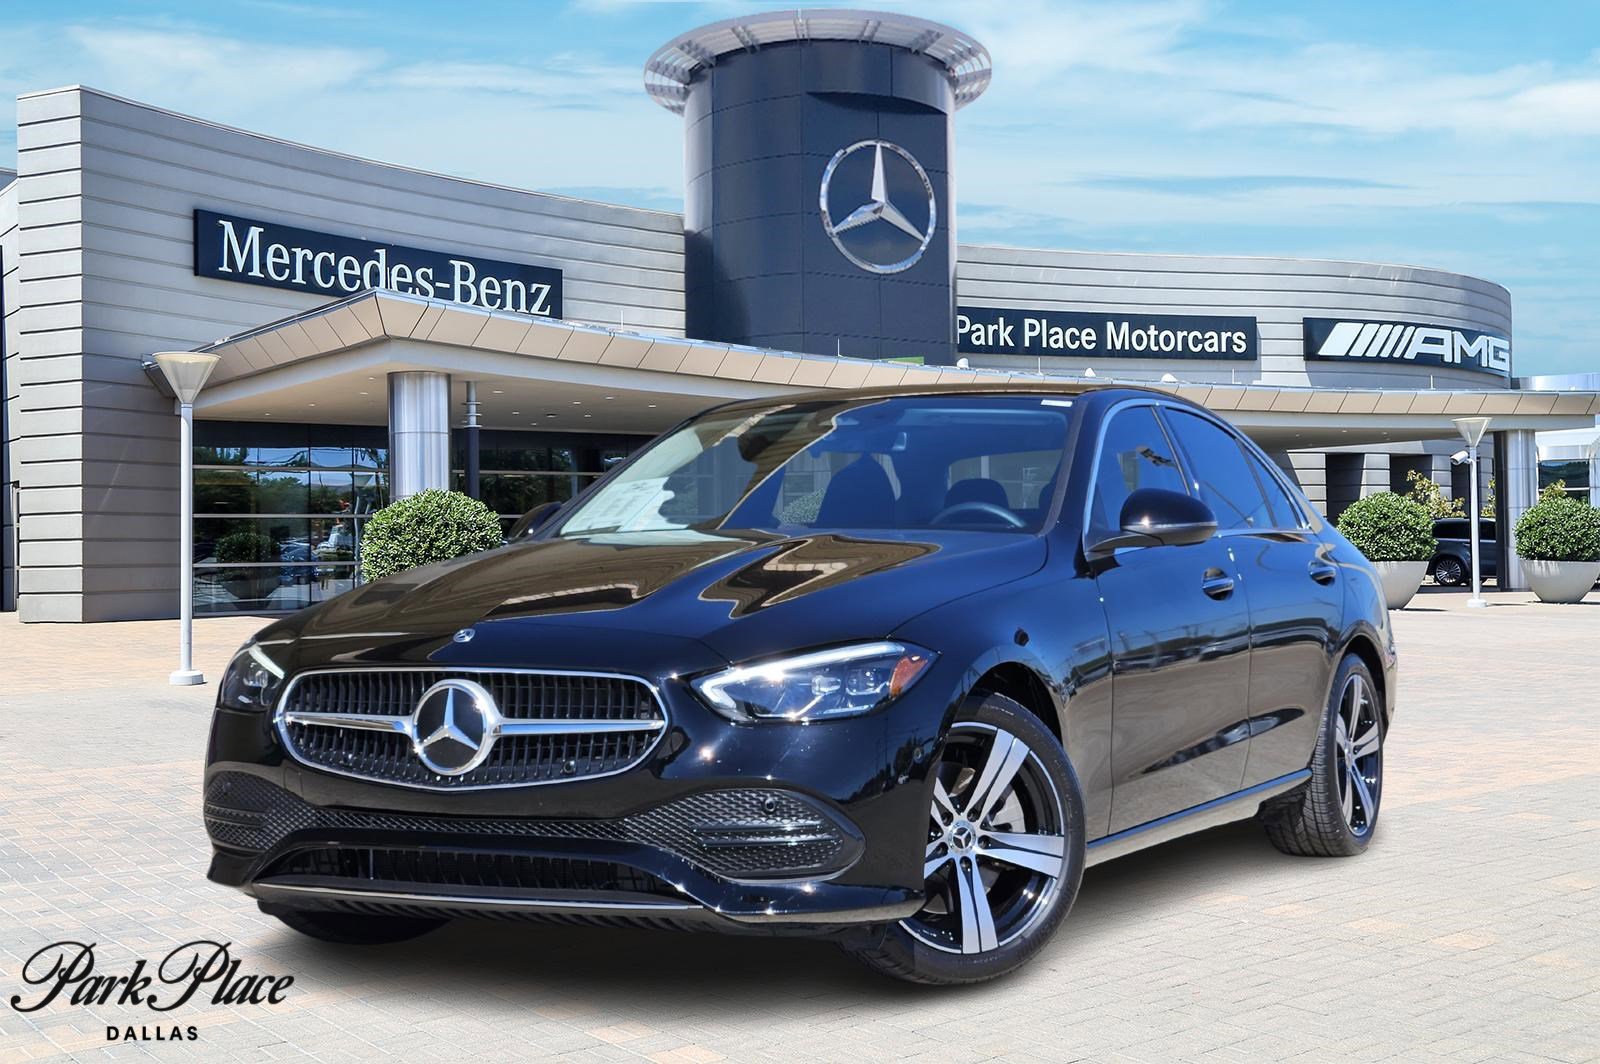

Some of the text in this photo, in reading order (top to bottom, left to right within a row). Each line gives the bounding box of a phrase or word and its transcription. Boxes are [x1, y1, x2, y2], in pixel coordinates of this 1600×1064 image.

[217, 219, 551, 316] Mercedes-Benz
[956, 314, 1248, 354] Park Place Motorcars
[1403, 326, 1510, 372] AMG
